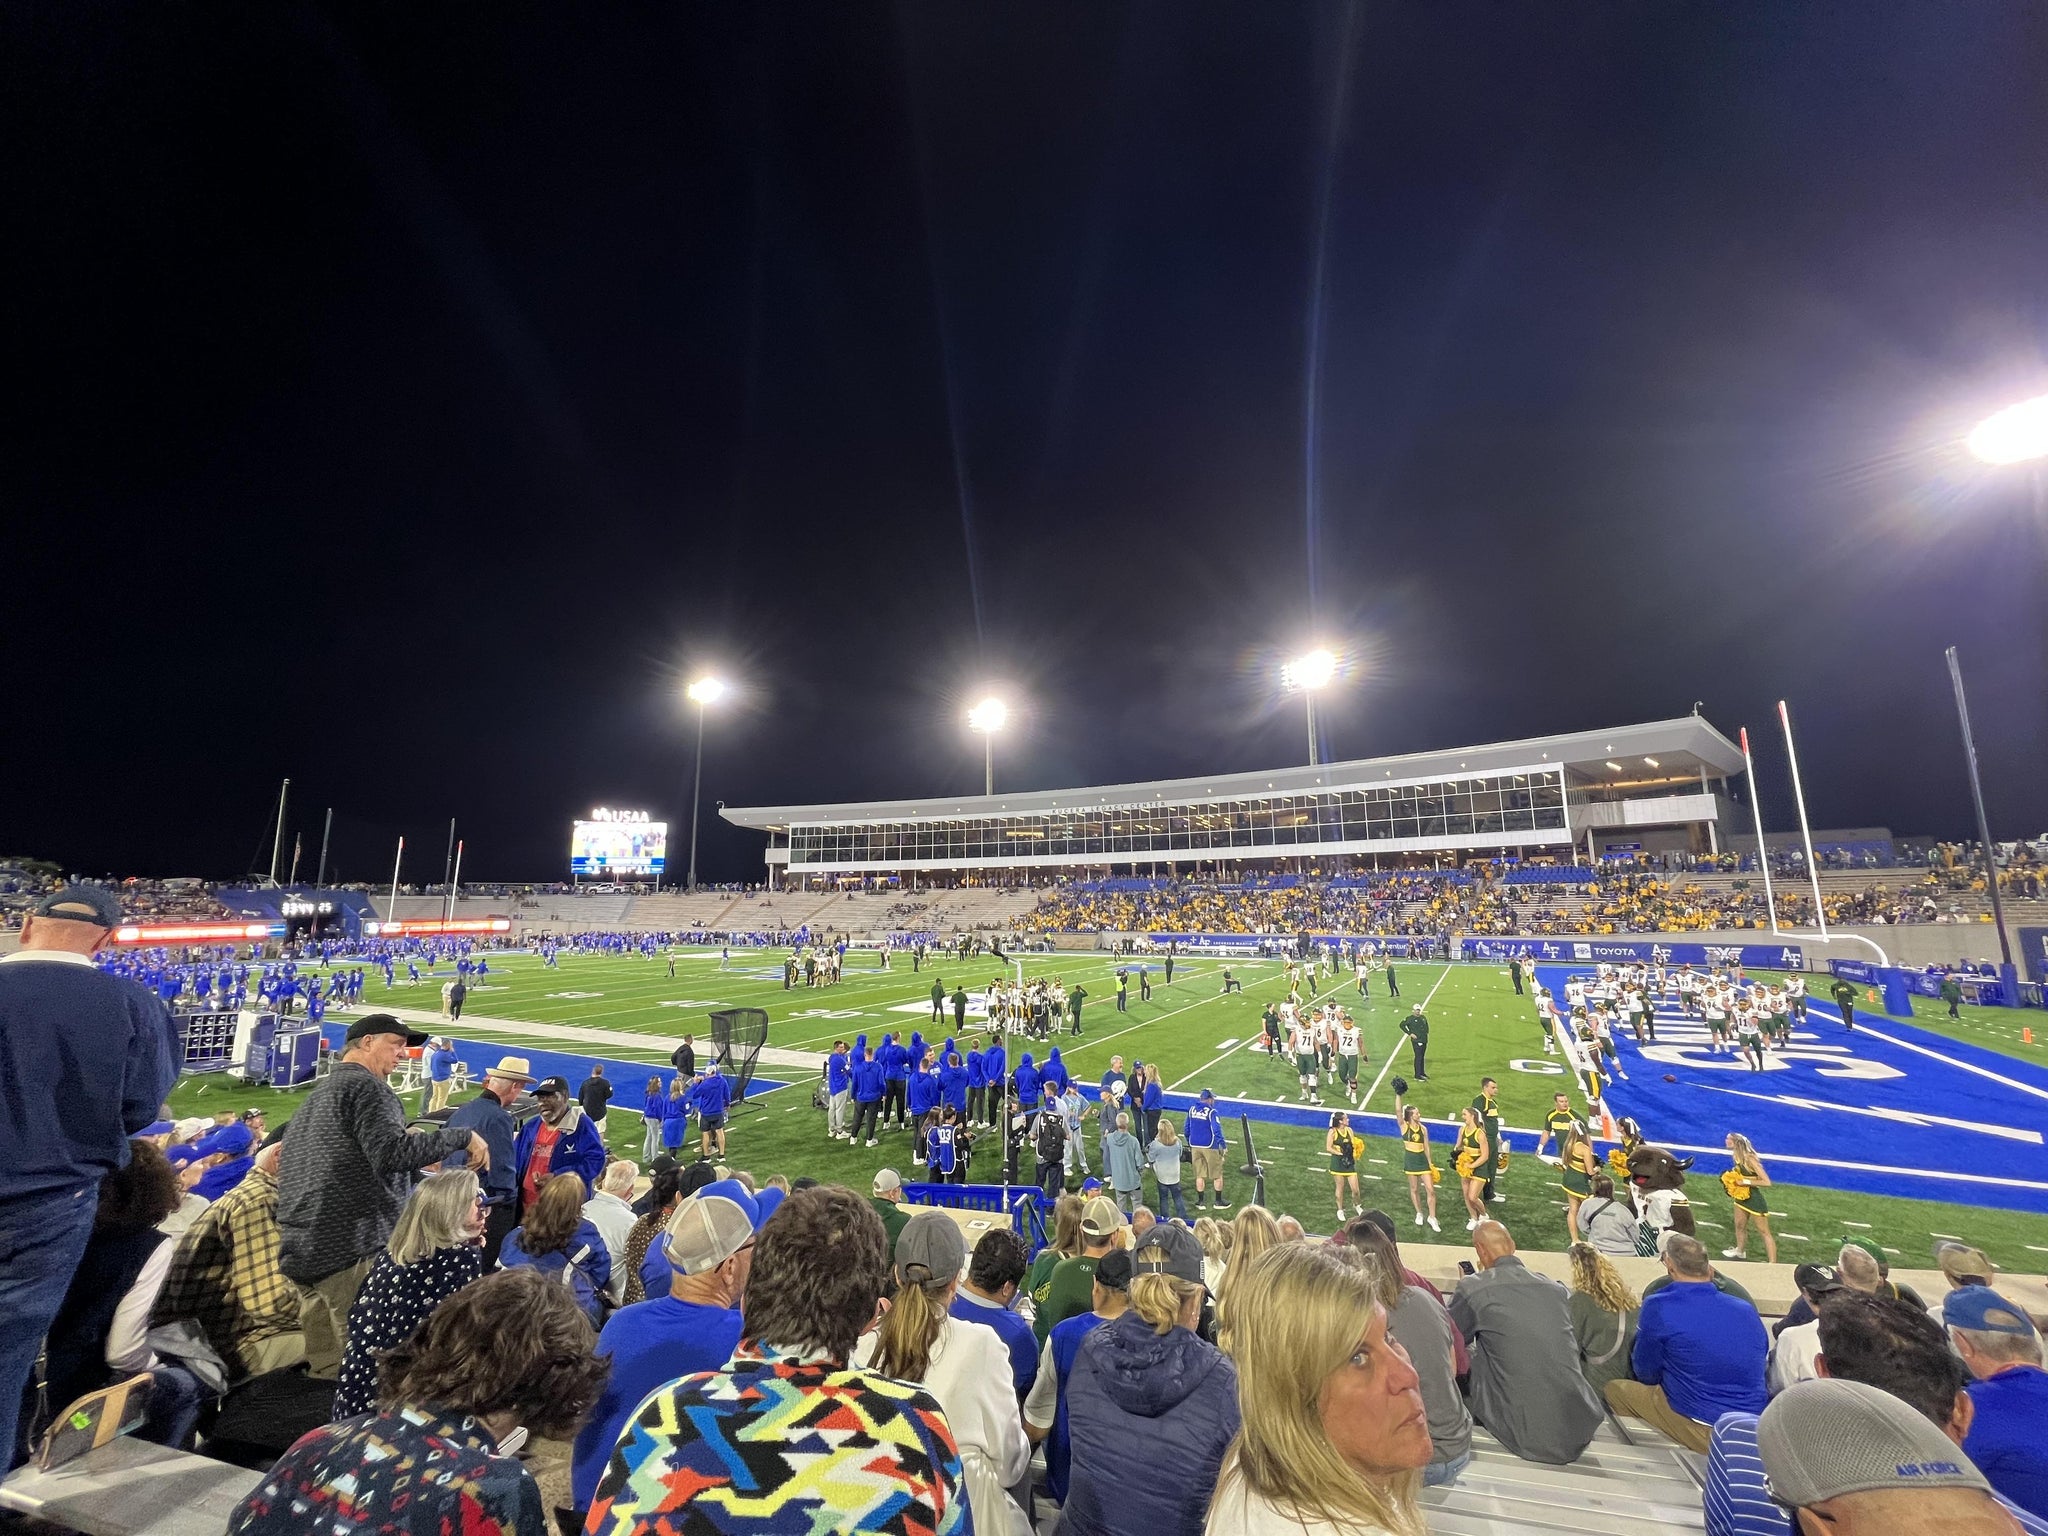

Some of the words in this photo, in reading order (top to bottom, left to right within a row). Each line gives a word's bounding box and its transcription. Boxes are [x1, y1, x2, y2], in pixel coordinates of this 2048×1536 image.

[1091, 804, 1125, 812] LEGACY
[1130, 801, 1166, 809] CENTER
[612, 810, 649, 822] USAA
[1594, 947, 1636, 956] TOYOTA
[1302, 1036, 1311, 1046] 71
[1343, 1036, 1352, 1047] 72
[1509, 1059, 1564, 1075] G
[1895, 1462, 1922, 1477] AIR
